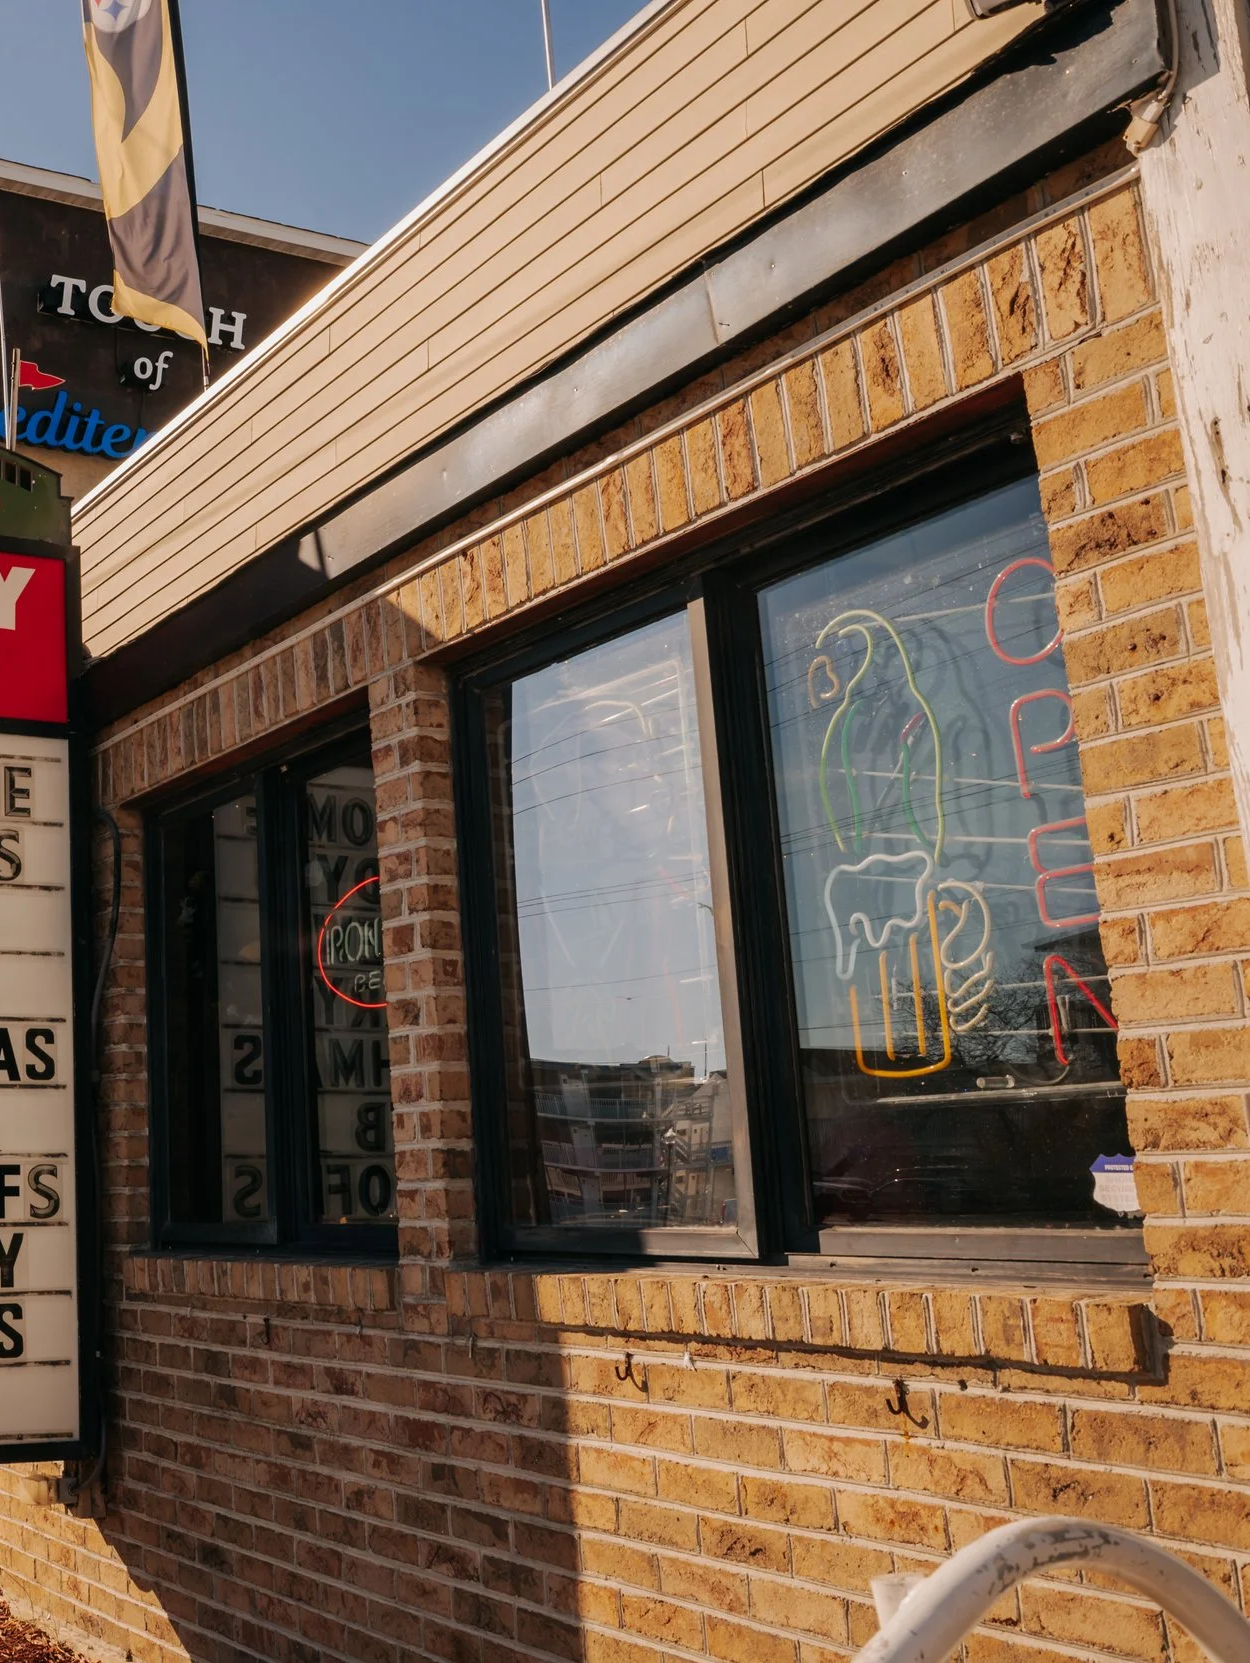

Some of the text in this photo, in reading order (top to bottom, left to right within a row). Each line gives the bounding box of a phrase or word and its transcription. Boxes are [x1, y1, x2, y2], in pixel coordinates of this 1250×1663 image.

[50, 274, 247, 350] TOH
[134, 351, 173, 391] of
[326, 917, 381, 965] IRON
